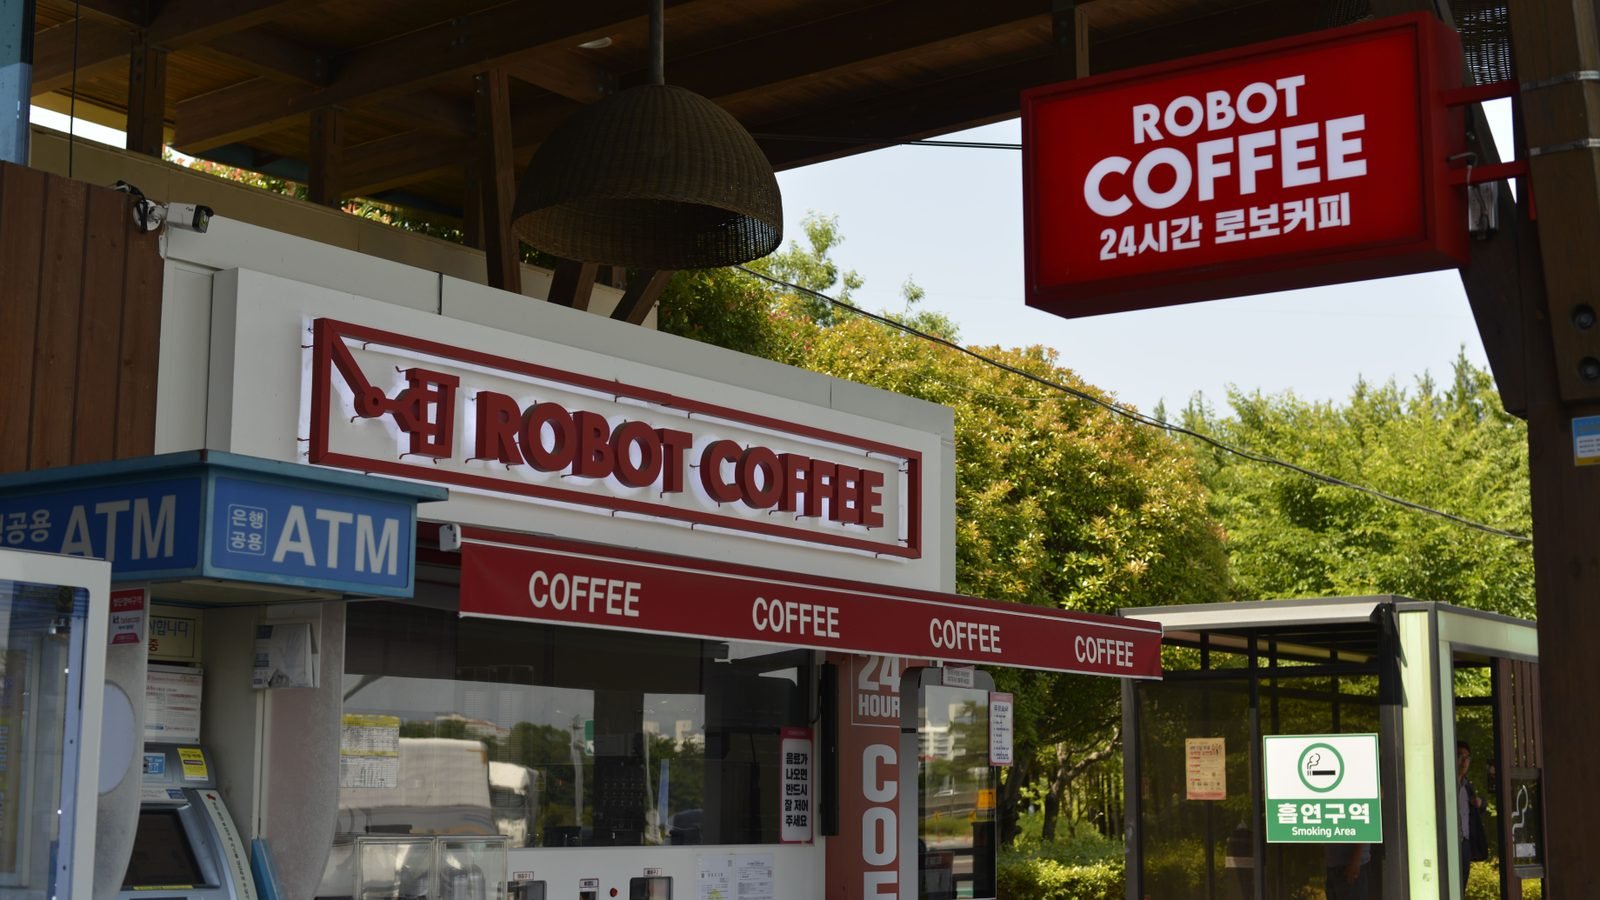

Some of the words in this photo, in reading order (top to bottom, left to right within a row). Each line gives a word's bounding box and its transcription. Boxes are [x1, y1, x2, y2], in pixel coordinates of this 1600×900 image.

[1133, 75, 1305, 144] ROBOT
[1084, 115, 1366, 216] COFFEE
[1101, 215, 1202, 260] 24시간
[1215, 192, 1351, 245] 로보커피
[475, 391, 692, 493] ROBOT
[700, 440, 884, 528] COFFEE
[60, 495, 177, 560] ATM
[231, 508, 265, 529] 은행
[230, 531, 263, 551] 공용
[272, 505, 399, 576] ATM
[530, 571, 640, 616] COFFEE
[753, 598, 839, 637] COFFEE
[930, 619, 1001, 653] COFFEE
[1075, 636, 1133, 667] COFFEE
[858, 655, 901, 692] 24
[786, 752, 808, 765] 음료가
[786, 768, 808, 781] 나오면
[785, 799, 792, 812] 잘
[794, 799, 808, 812] 저어
[786, 783, 808, 796] 반드시
[786, 815, 808, 827] 주세요
[1277, 802, 1370, 825] 흡연구역
[1292, 826, 1331, 839] Smoking
[1334, 827, 1357, 837] Area
